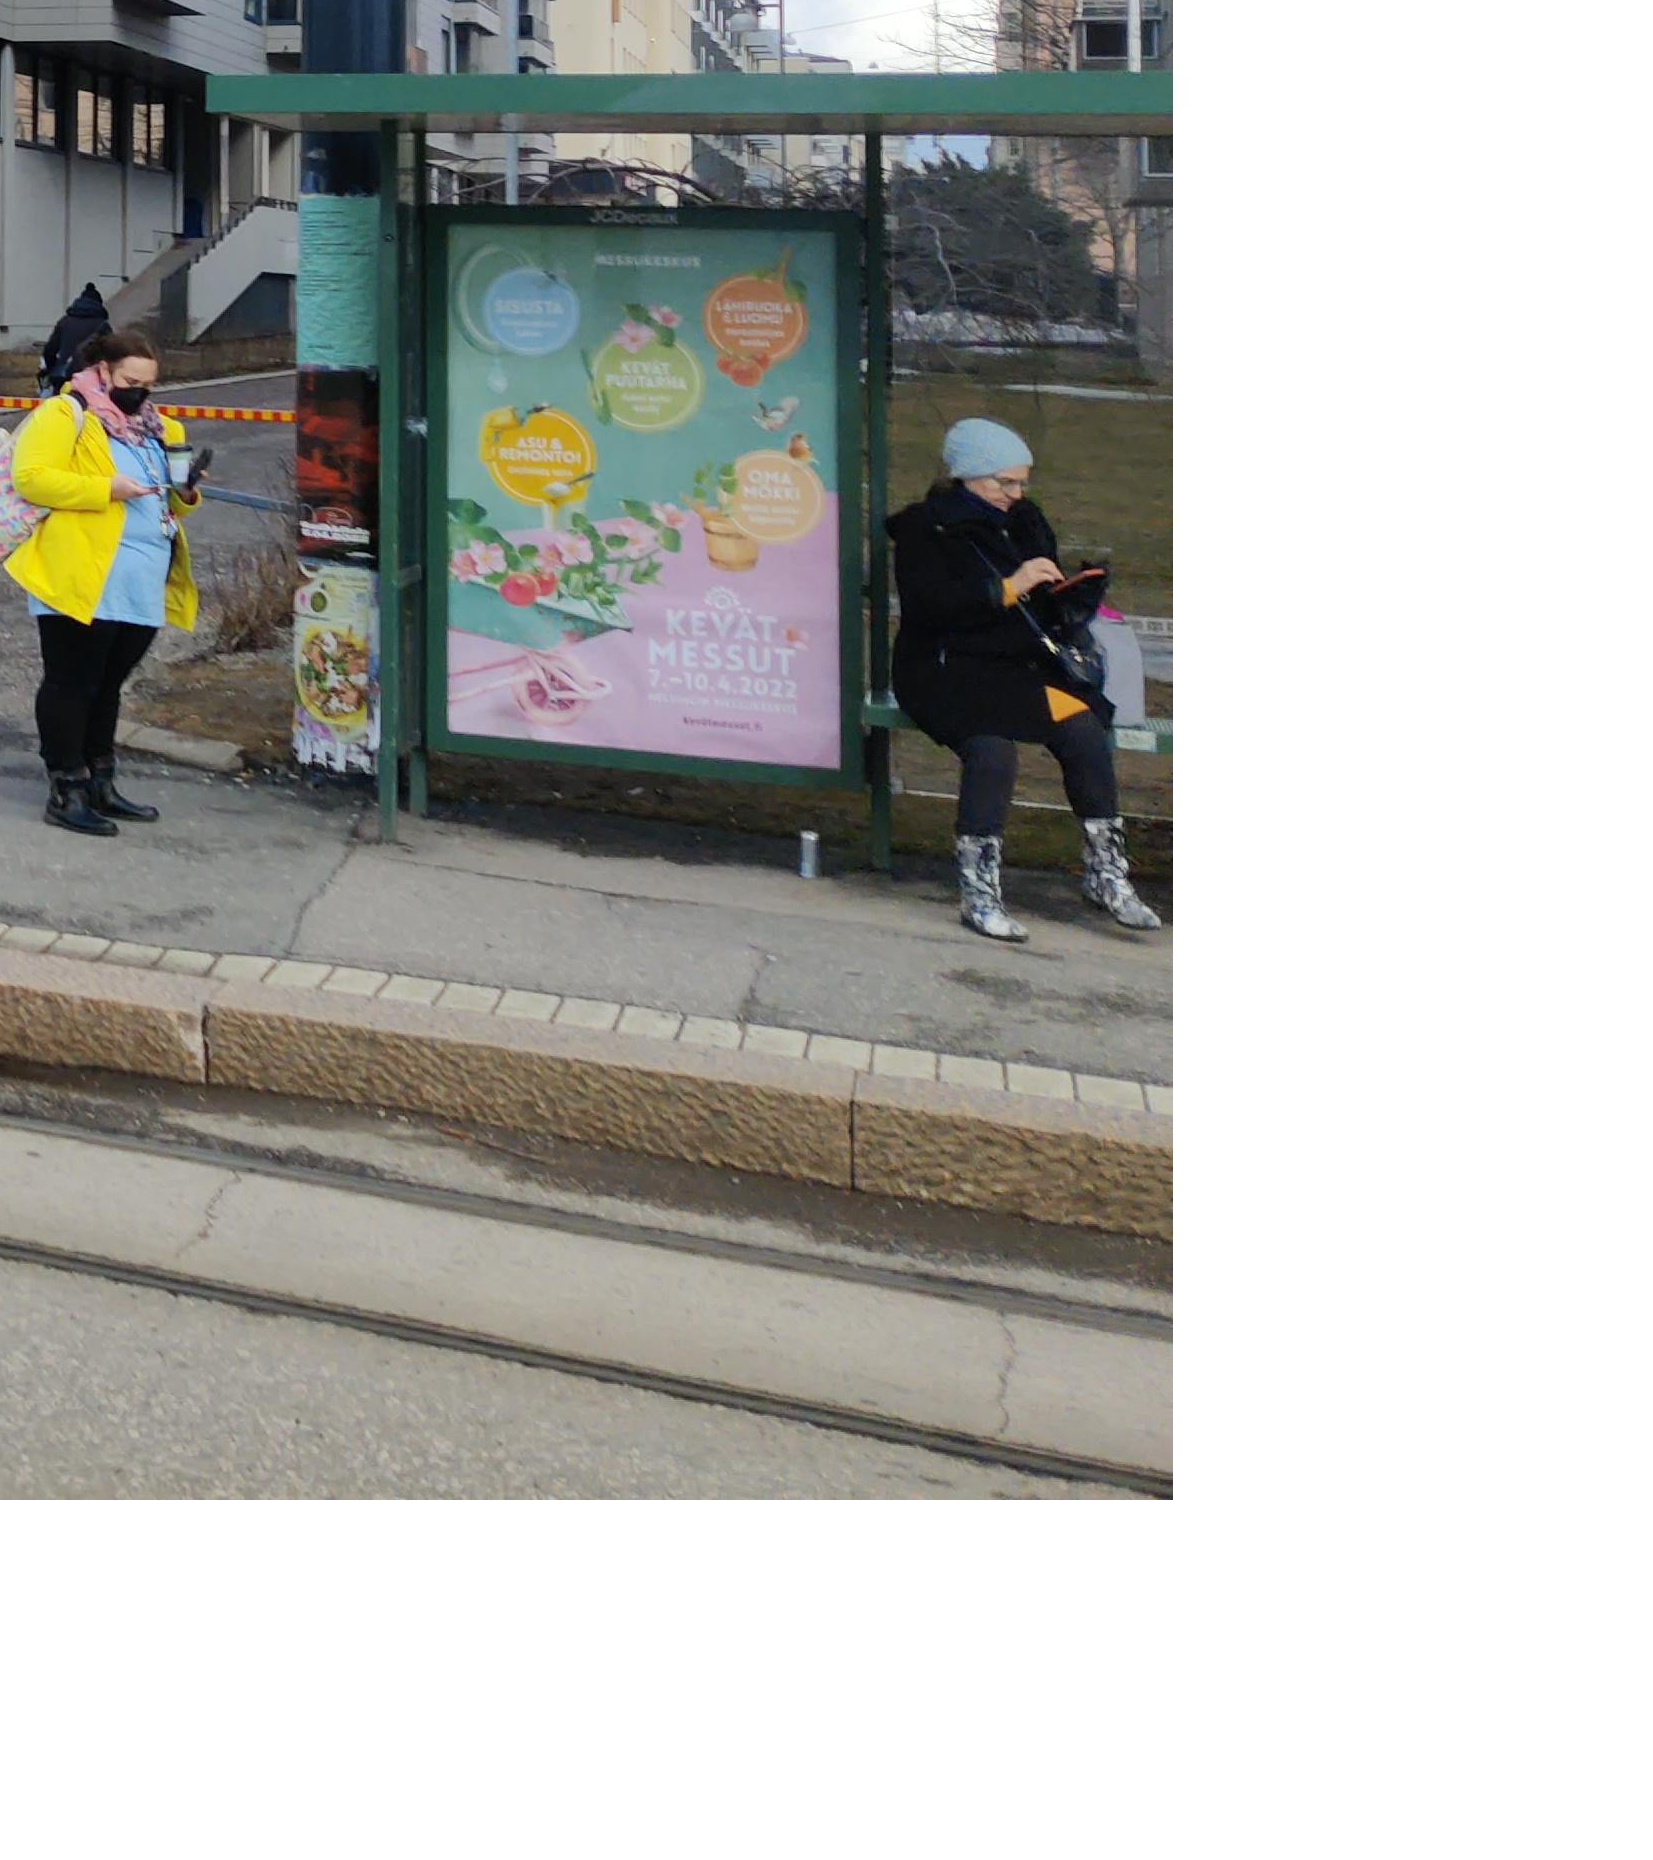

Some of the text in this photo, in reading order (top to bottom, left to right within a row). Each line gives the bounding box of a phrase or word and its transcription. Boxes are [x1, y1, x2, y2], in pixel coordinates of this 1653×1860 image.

[591, 209, 678, 225] JCDecaux
[494, 298, 564, 316] SISUSTA
[605, 372, 688, 392] PUUTARHA
[516, 436, 563, 451] ASU &
[499, 447, 582, 466] REMONTOI
[747, 467, 792, 487] OMA
[665, 607, 779, 642] KEVÄT
[648, 637, 796, 677] MESSUT
